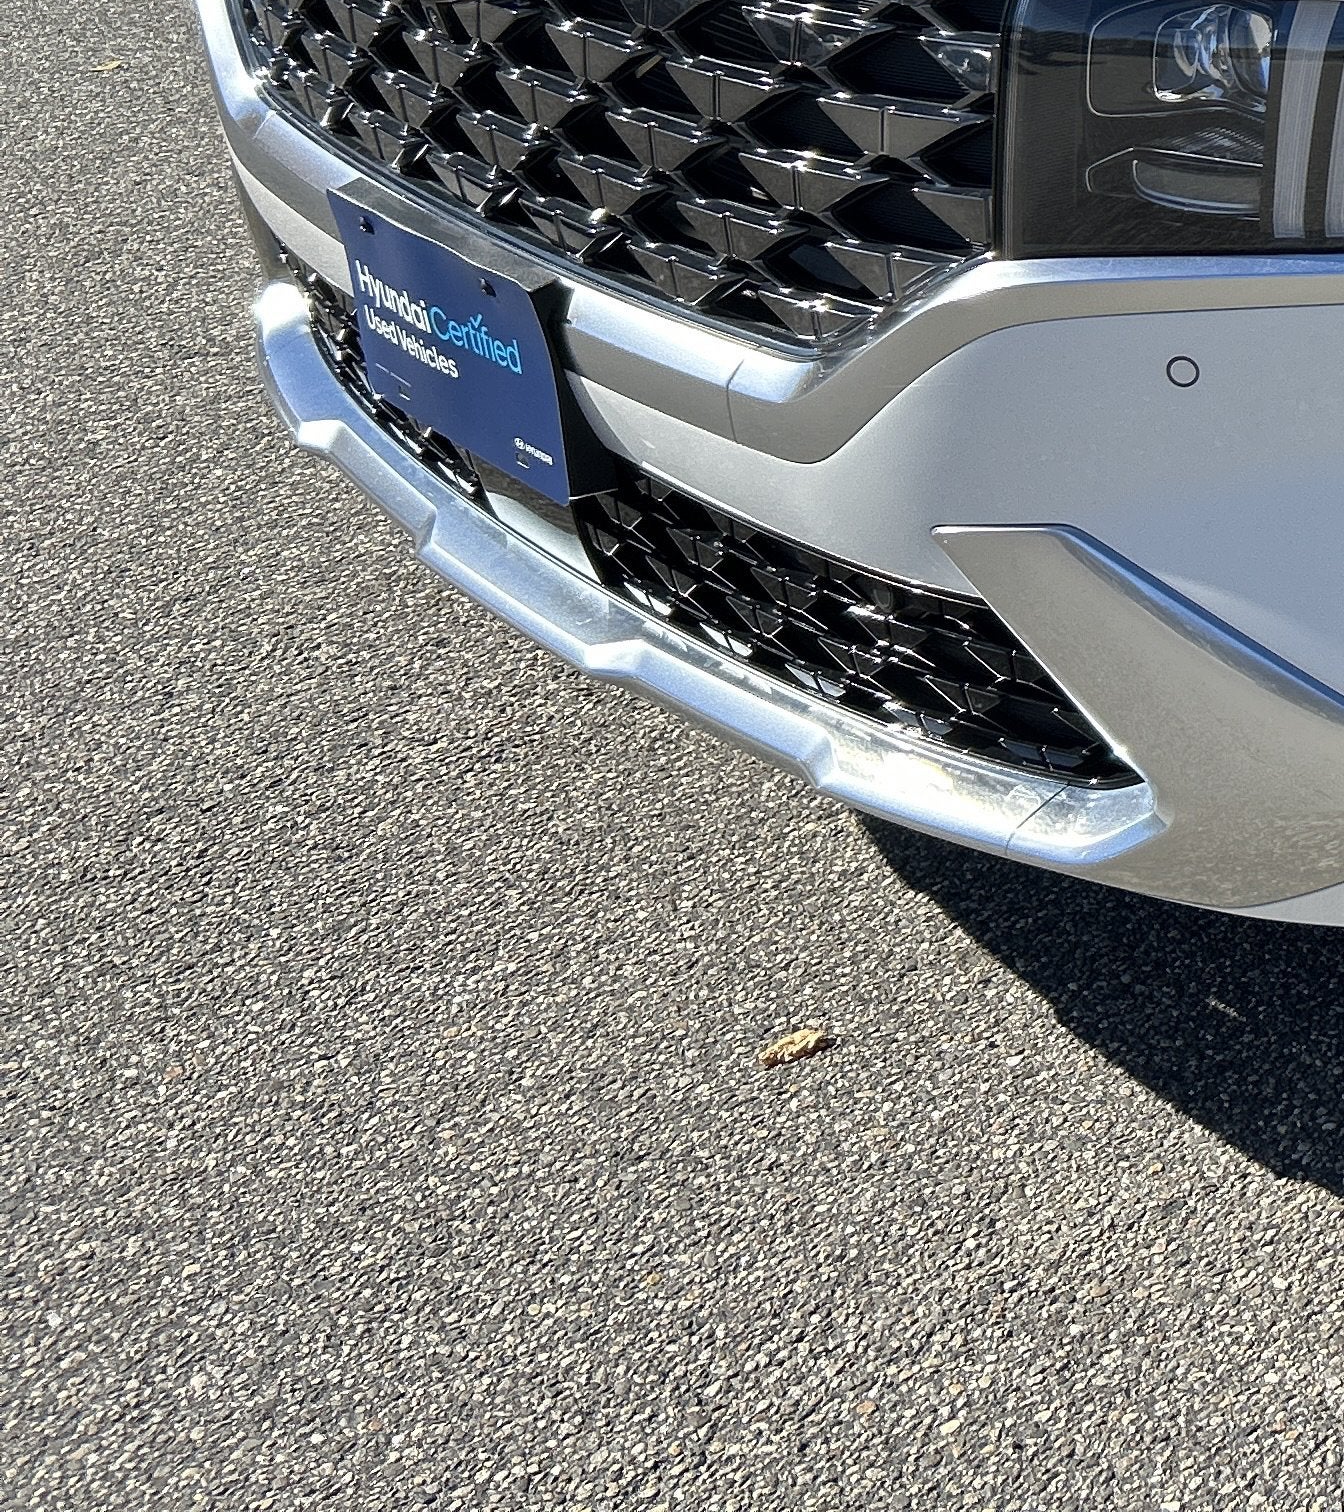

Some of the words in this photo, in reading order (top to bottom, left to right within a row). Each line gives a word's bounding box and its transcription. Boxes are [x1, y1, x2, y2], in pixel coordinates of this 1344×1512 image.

[355, 259, 432, 334] Hyundai
[427, 306, 523, 375] Certified
[363, 304, 399, 346] Used
[397, 324, 460, 379] Vehicles
